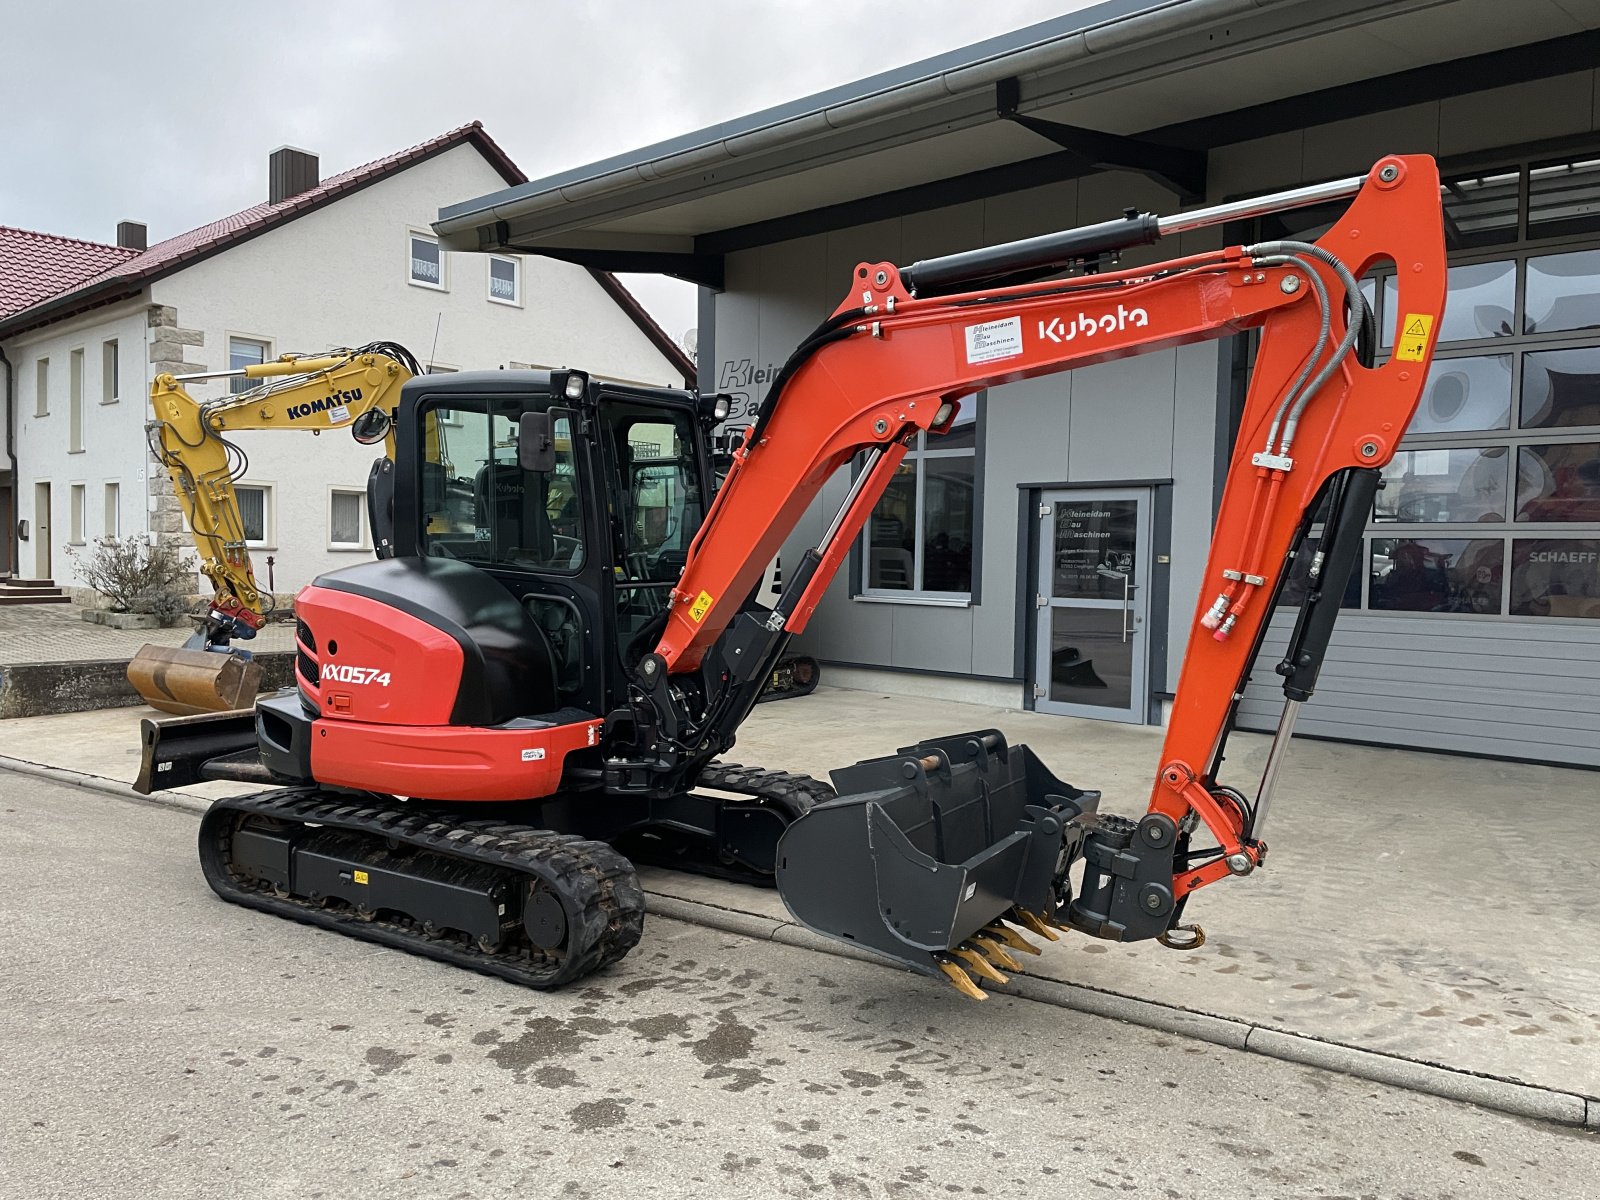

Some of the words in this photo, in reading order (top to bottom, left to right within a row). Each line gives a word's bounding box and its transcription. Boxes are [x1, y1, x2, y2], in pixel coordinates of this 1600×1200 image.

[973, 321, 1014, 335] Kleineidam
[1038, 304, 1149, 343] Kubota
[974, 333, 991, 342] Bau
[975, 337, 1015, 349] Maschinen
[287, 388, 363, 420] KOMATSU
[1060, 508, 1111, 518] Kleineidam
[1060, 519, 1082, 528] Bau
[1060, 529, 1111, 539] Maschinen
[1529, 551, 1597, 563] SCHAEFF
[321, 663, 391, 687] KX057-4
